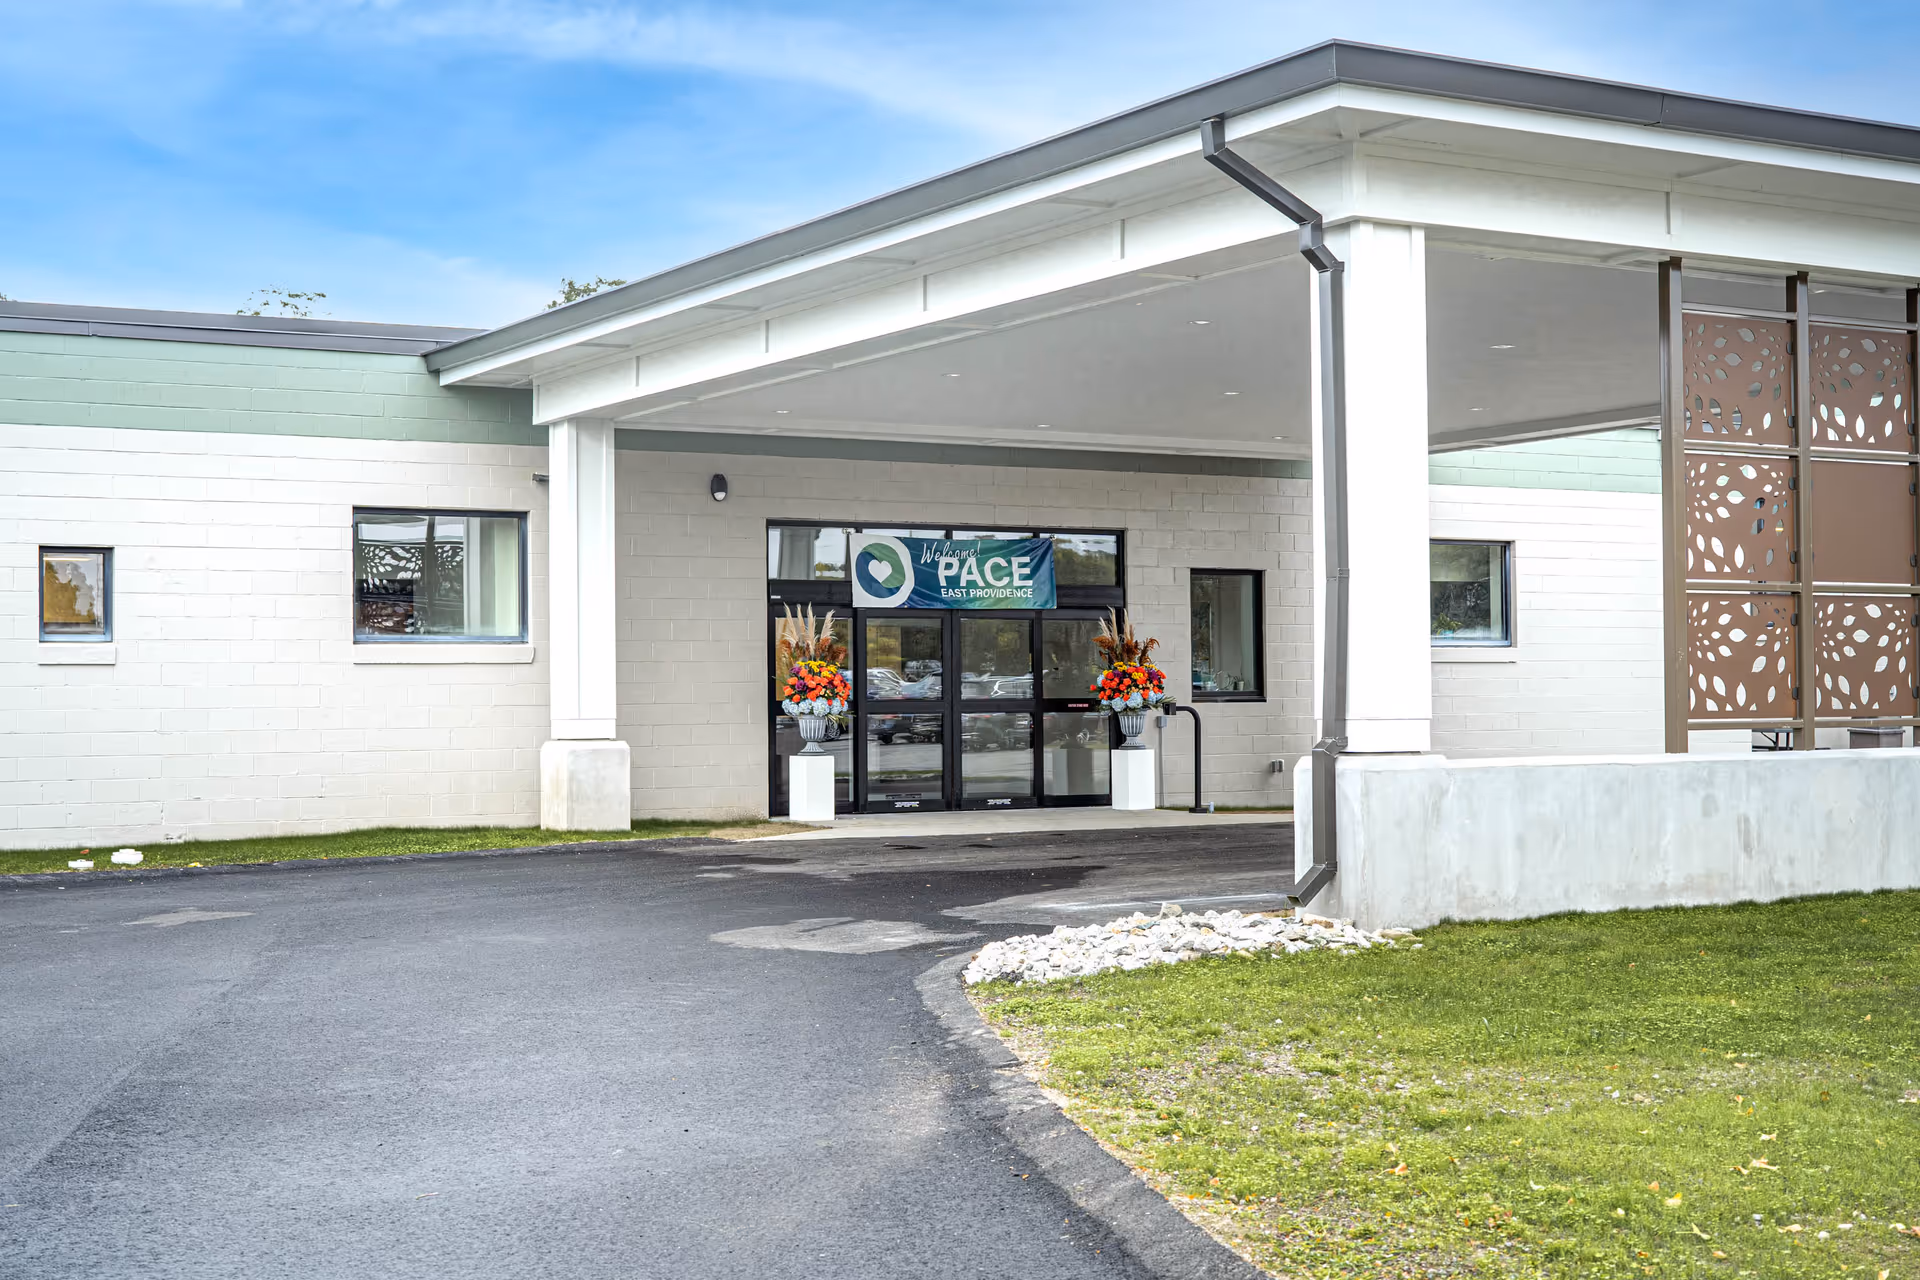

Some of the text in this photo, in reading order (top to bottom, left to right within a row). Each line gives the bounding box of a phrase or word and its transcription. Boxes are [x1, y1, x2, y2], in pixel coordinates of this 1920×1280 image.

[921, 541, 981, 564] Welcome!
[938, 557, 1033, 587] PACE
[941, 588, 1033, 598] EAST PROVIDENCE
